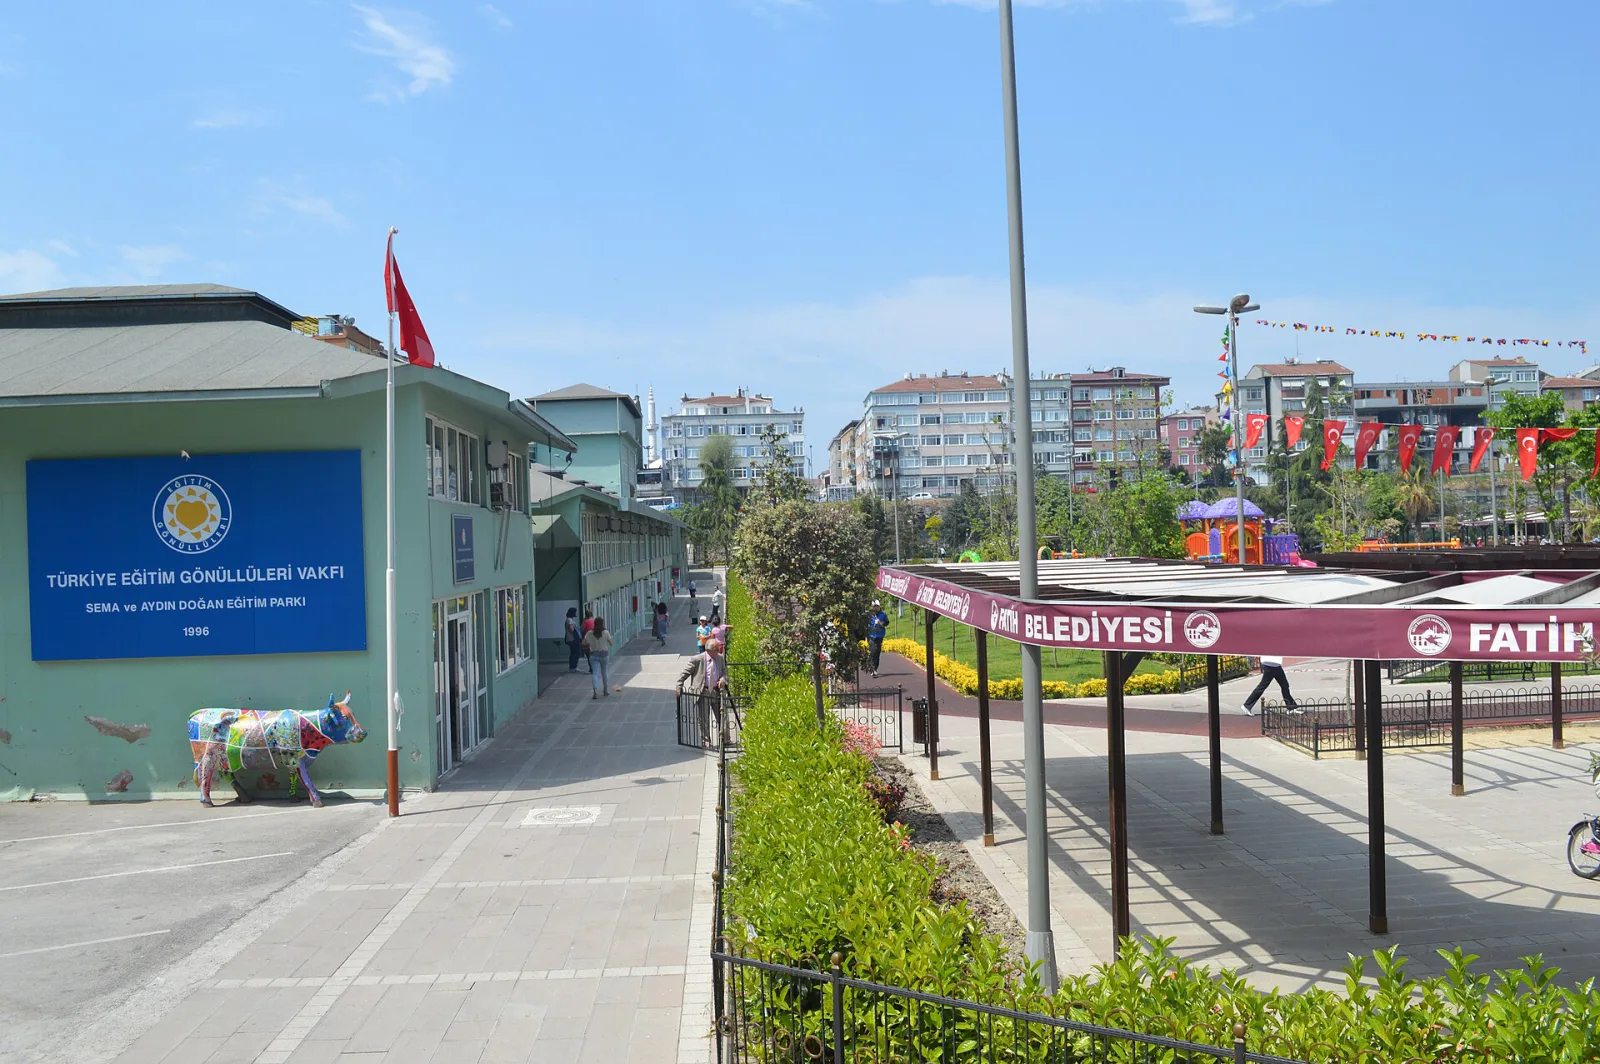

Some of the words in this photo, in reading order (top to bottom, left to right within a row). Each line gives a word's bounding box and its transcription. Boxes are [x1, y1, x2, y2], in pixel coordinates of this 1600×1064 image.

[167, 477, 212, 493] EĞİTİM
[157, 517, 229, 551] GÖNÜLLÜLERİ
[47, 569, 117, 588] TÜRKİYE
[121, 567, 175, 586] EĞİTİM
[180, 564, 292, 584] GÖNÜLLÜLERİ
[297, 565, 344, 580] VAKFI
[86, 603, 120, 613] SEMA
[123, 604, 137, 612] ve
[141, 601, 176, 611] AYDIN
[179, 597, 224, 610] DOĞAN
[226, 596, 267, 609] EĞİTİM
[270, 597, 306, 607] PARKI
[183, 626, 210, 637] 1996
[999, 604, 1019, 634] FATİH
[1025, 610, 1173, 644] BELEDİYESİ
[1470, 615, 1594, 653] FATİH
